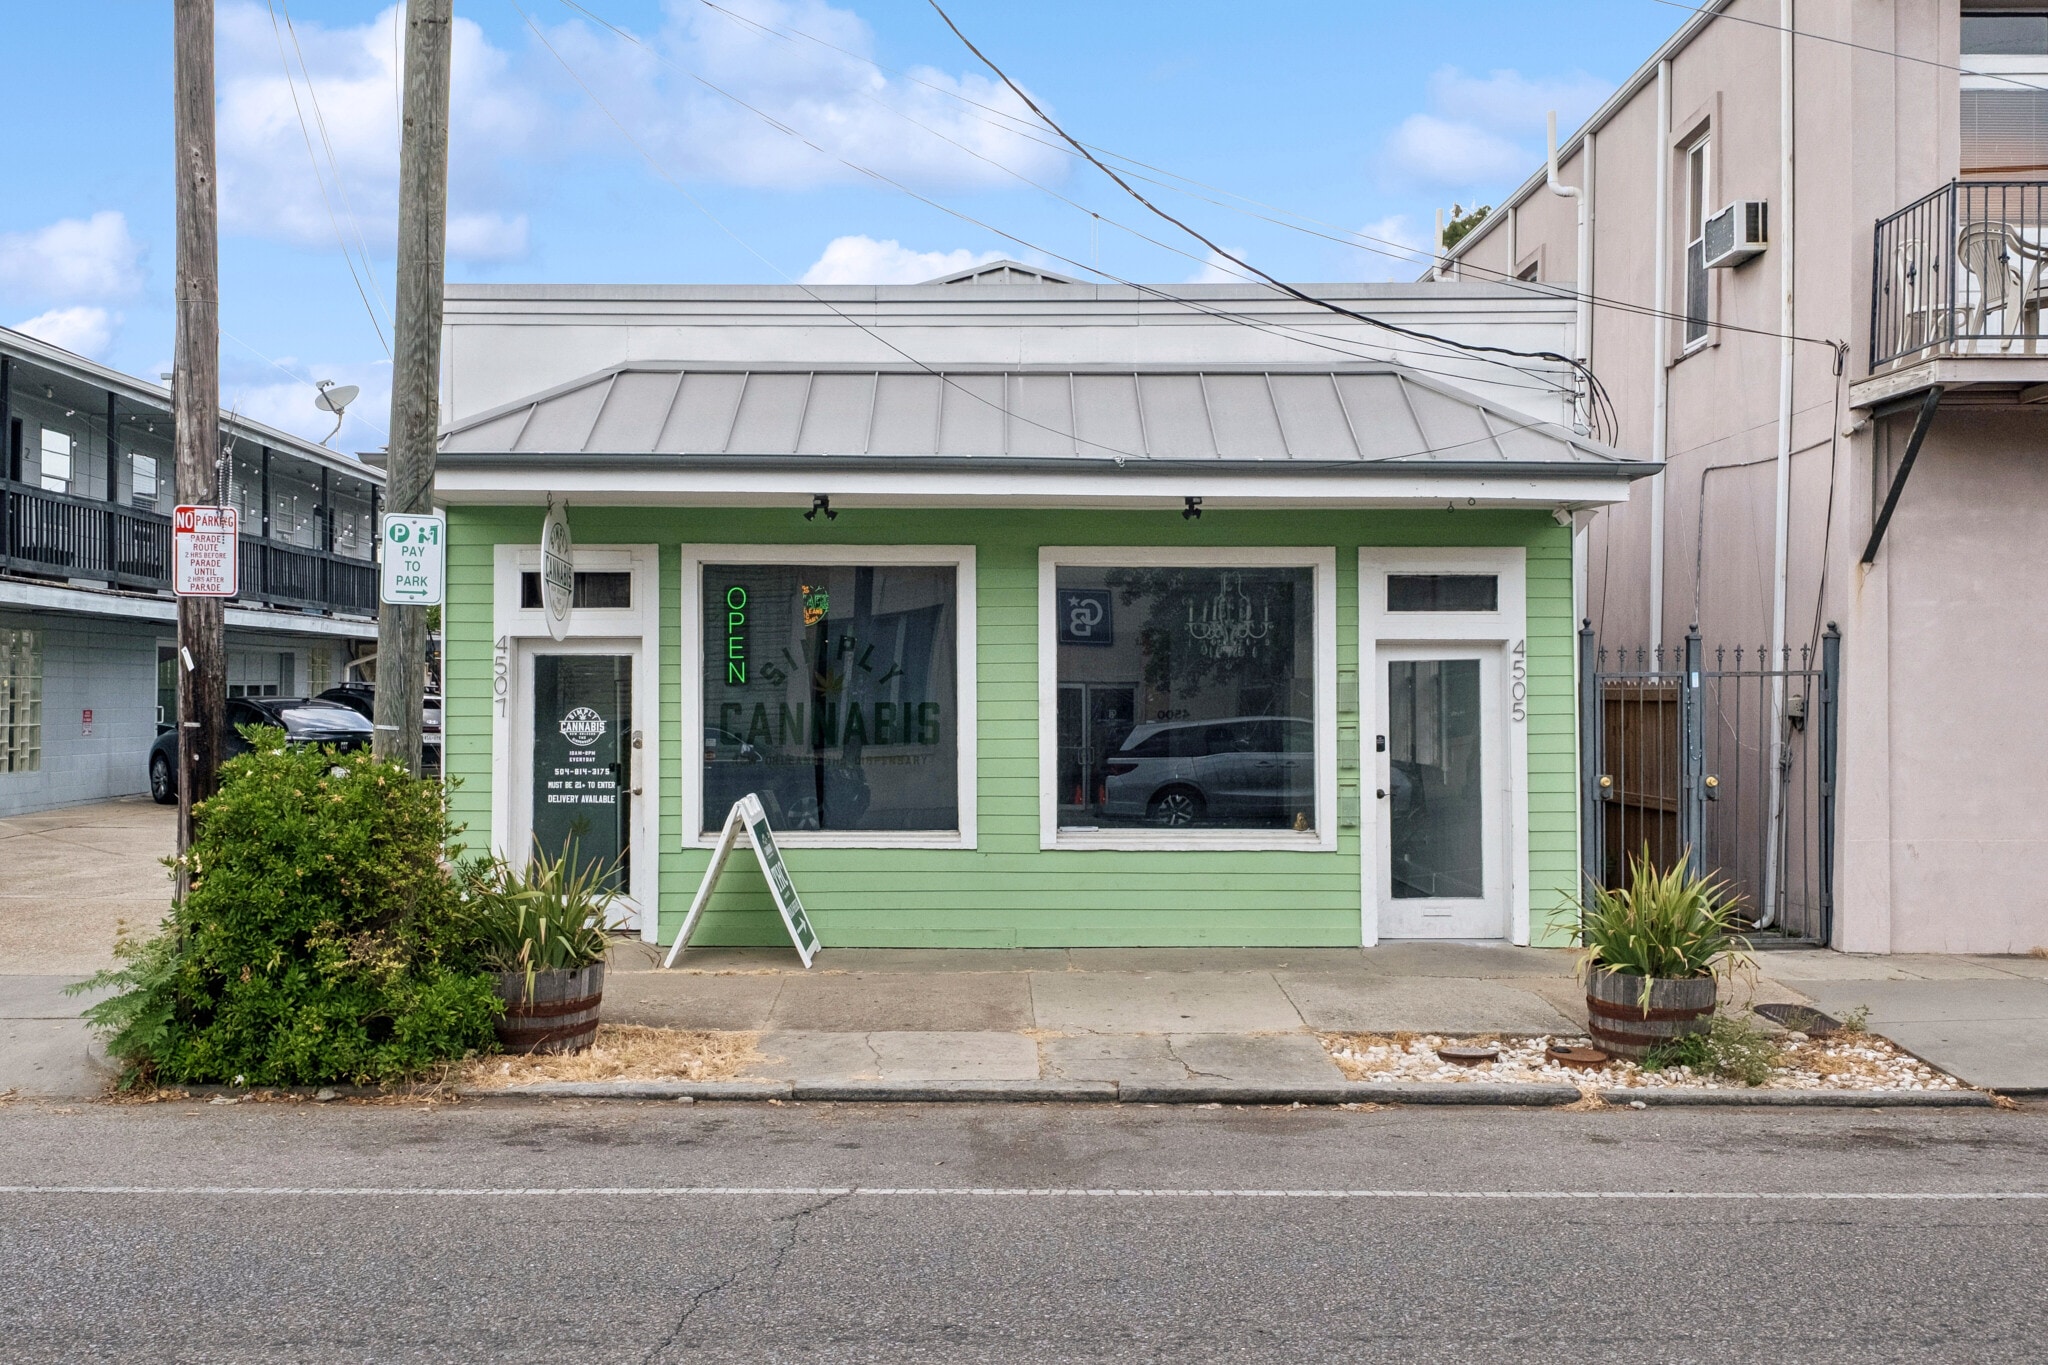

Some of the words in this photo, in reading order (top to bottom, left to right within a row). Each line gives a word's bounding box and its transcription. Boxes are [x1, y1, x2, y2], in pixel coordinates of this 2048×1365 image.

[25, 447, 30, 459] 2
[176, 511, 194, 529] NO
[195, 514, 234, 527] PARKG
[190, 534, 221, 543] PARADE
[193, 543, 219, 551] ROUTE
[401, 546, 425, 557] PAY
[190, 559, 221, 567] PARADE
[405, 561, 421, 572] TO
[194, 568, 217, 576] UNTIL
[396, 575, 428, 587] PARK
[727, 586, 747, 684] OPEN
[494, 635, 508, 718] 4501
[1512, 639, 1526, 721] 4505
[569, 708, 598, 720] SIMPLY
[560, 722, 605, 731] CANNABIS
[719, 701, 942, 746] CANNABIS
[547, 781, 563, 789] MUST
[564, 781, 573, 789] BE
[588, 781, 596, 789] TO
[547, 795, 579, 803] DELIVERY
[581, 795, 616, 804] AVAILABLE
